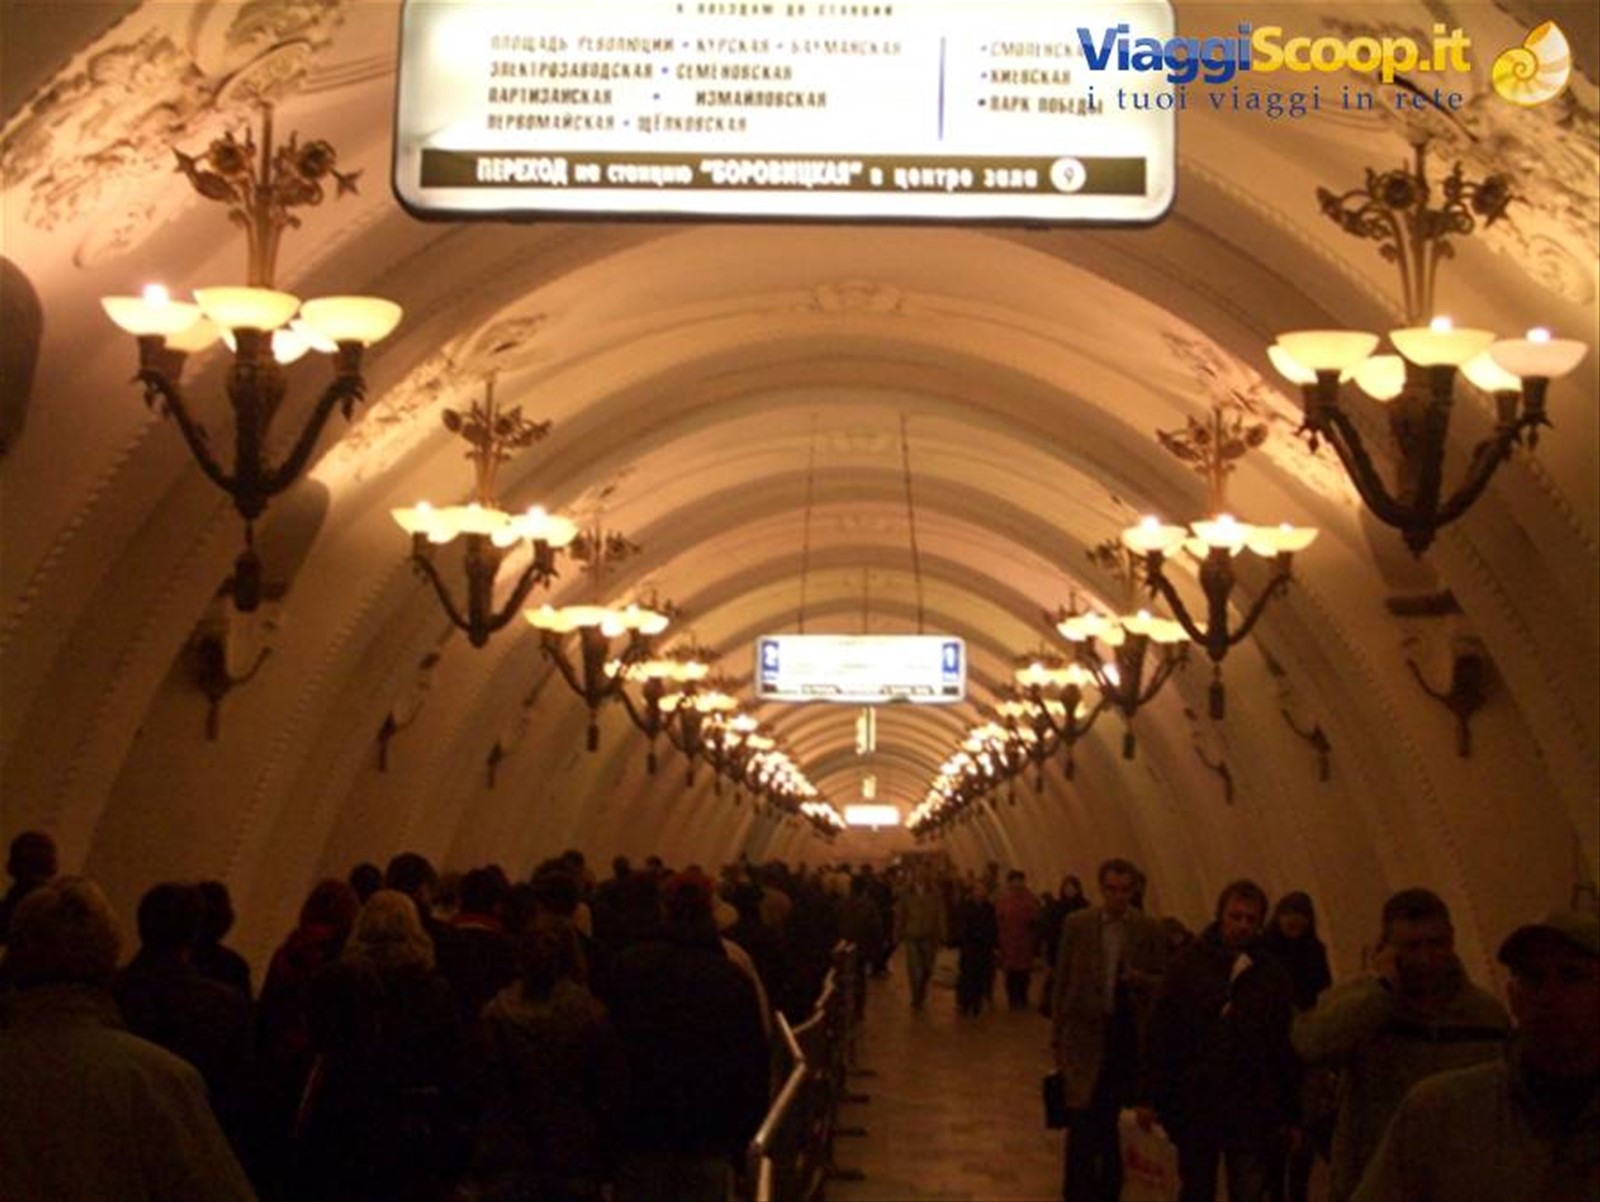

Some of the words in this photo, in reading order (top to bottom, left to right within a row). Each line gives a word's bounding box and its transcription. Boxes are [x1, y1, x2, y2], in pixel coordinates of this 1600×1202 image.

[578, 36, 675, 54] РЕВОЛЮЦИИ
[696, 39, 770, 53] КУРСКАЯ
[490, 61, 653, 80] ЭЛЕКТРОЗАВОДСКАЯ
[991, 69, 1071, 85] КИЕВСКАЯ
[488, 87, 612, 104] ПАРТИЗАНСКАЯ
[695, 89, 827, 107] ИЗМАЙЛОВСКАЯ
[991, 96, 1030, 112] ПАРК
[487, 114, 615, 131] ПЕРВОМАЙСКАЯ
[477, 158, 568, 186] ПЕРЕХОД
[608, 164, 693, 187] станцию
